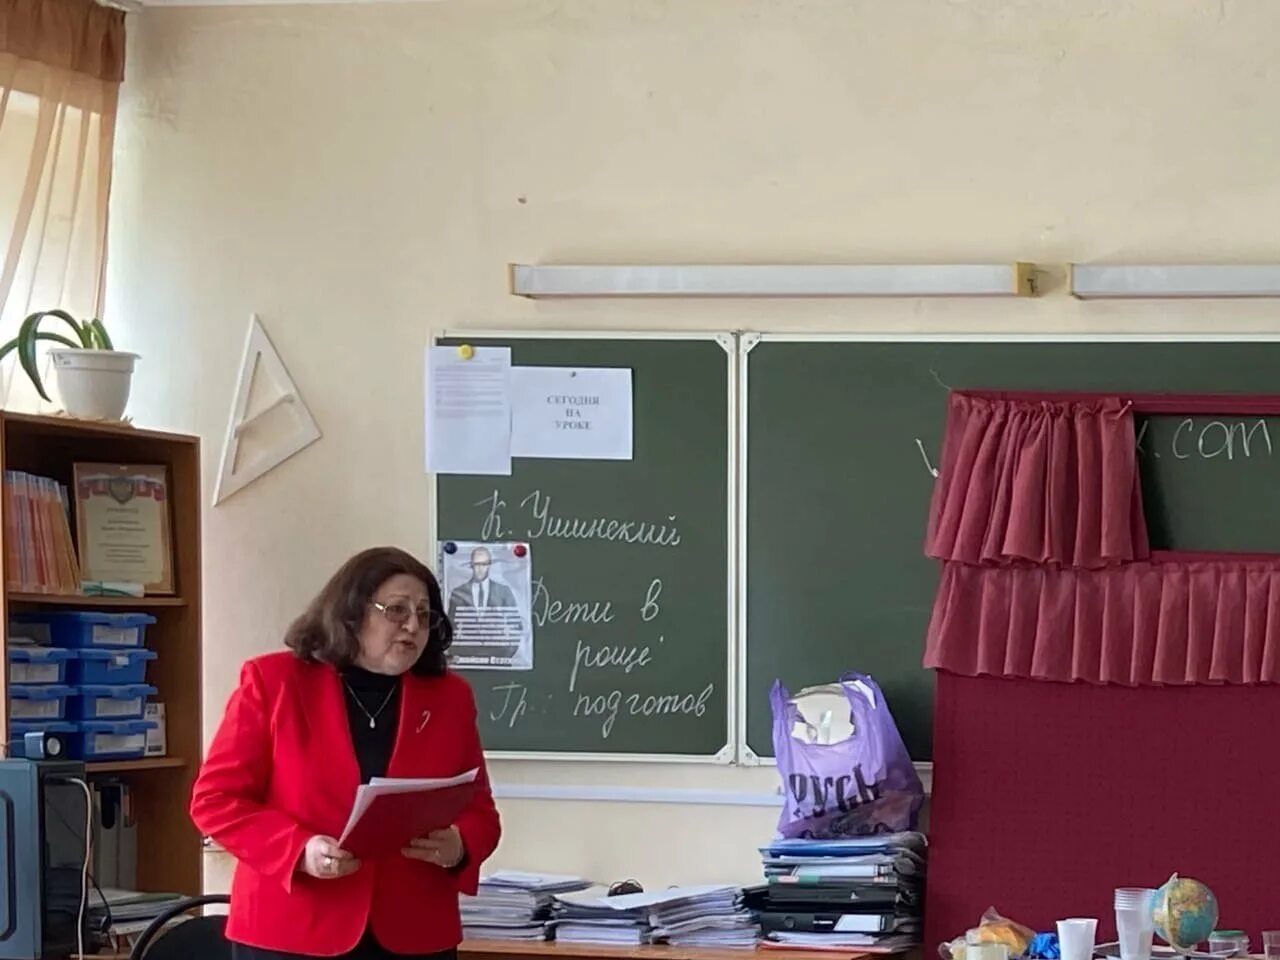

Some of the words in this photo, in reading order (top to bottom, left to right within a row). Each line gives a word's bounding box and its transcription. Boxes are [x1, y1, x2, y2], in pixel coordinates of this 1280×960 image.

[546, 395, 600, 406] СЕГОДНЯ
[555, 421, 592, 430] УРОКЕ
[520, 490, 682, 547] Ушинский
